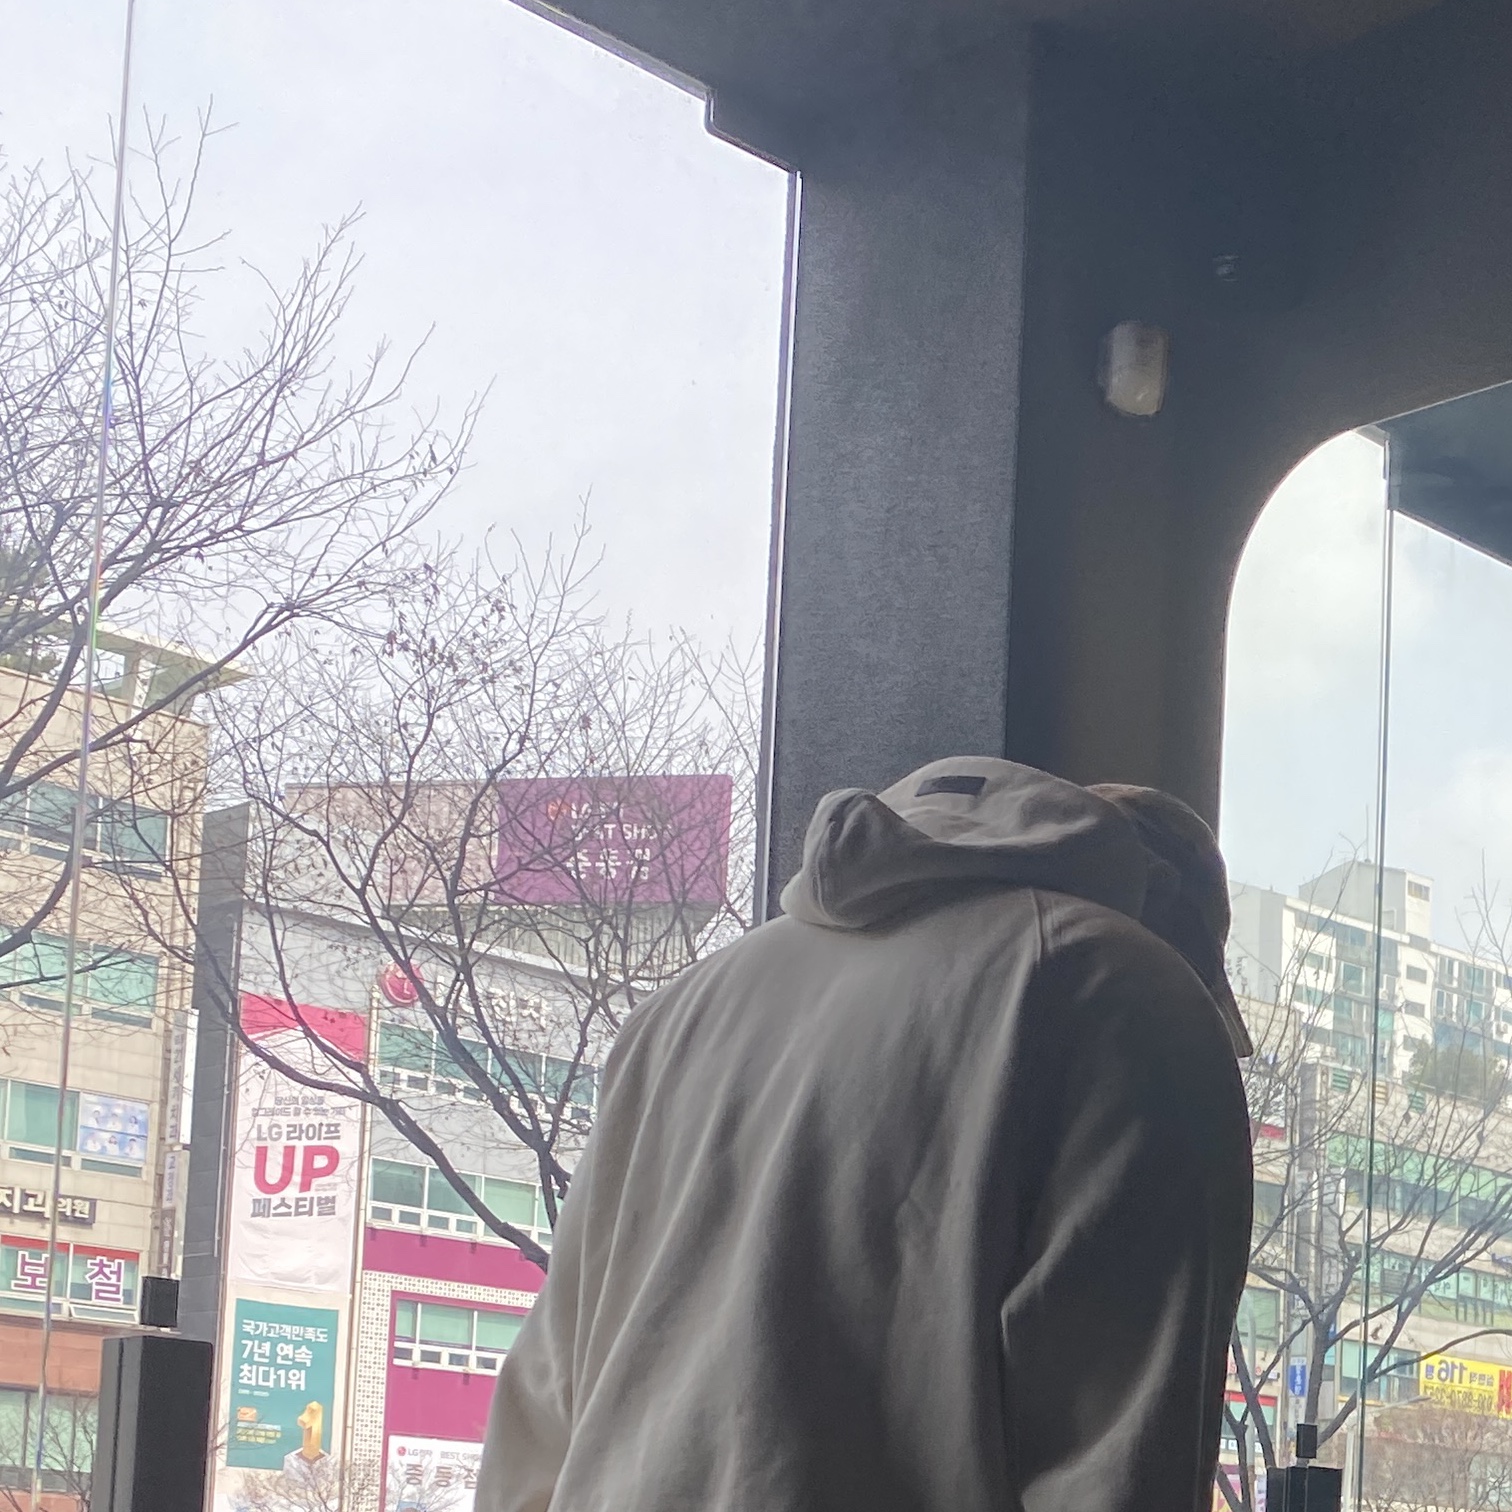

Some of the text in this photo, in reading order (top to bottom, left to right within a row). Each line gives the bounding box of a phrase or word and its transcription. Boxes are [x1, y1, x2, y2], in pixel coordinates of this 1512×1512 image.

[257, 1122, 341, 1141] LG 라이프
[254, 1145, 340, 1195] UP
[250, 1195, 337, 1218] 페스티벌
[242, 1319, 328, 1342] 국가고객만족도
[241, 1340, 313, 1367] 7년 연속
[238, 1363, 306, 1391] 최다1위
[462, 1452, 480, 1461] SHO
